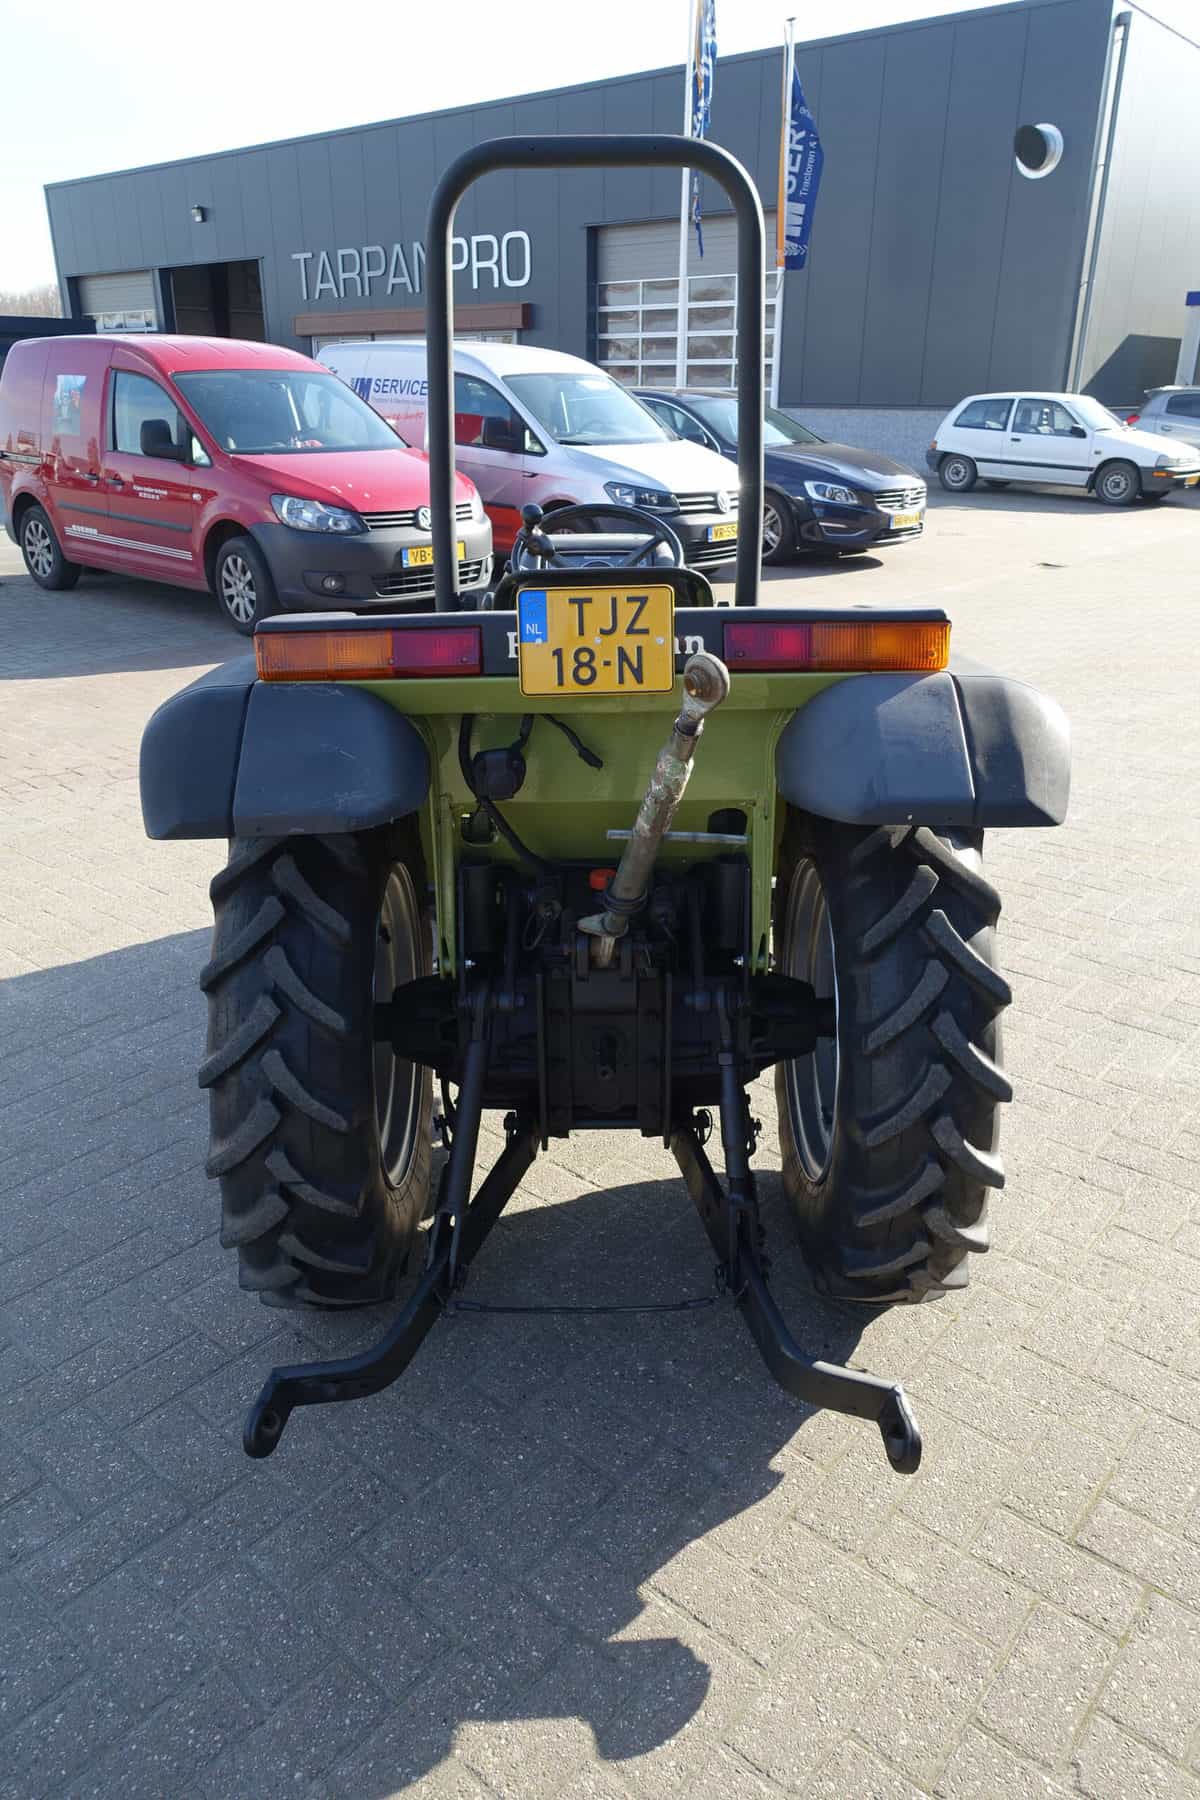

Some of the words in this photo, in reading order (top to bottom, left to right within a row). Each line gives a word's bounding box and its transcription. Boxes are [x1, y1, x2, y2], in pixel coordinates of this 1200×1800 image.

[800, 151, 816, 197] Tractoren
[290, 240, 426, 300] TARPAN
[451, 230, 531, 289] PRO
[373, 378, 428, 396] SERVICE
[525, 623, 543, 635] NL
[568, 596, 650, 637] TJZ
[552, 645, 645, 687] 18-N
